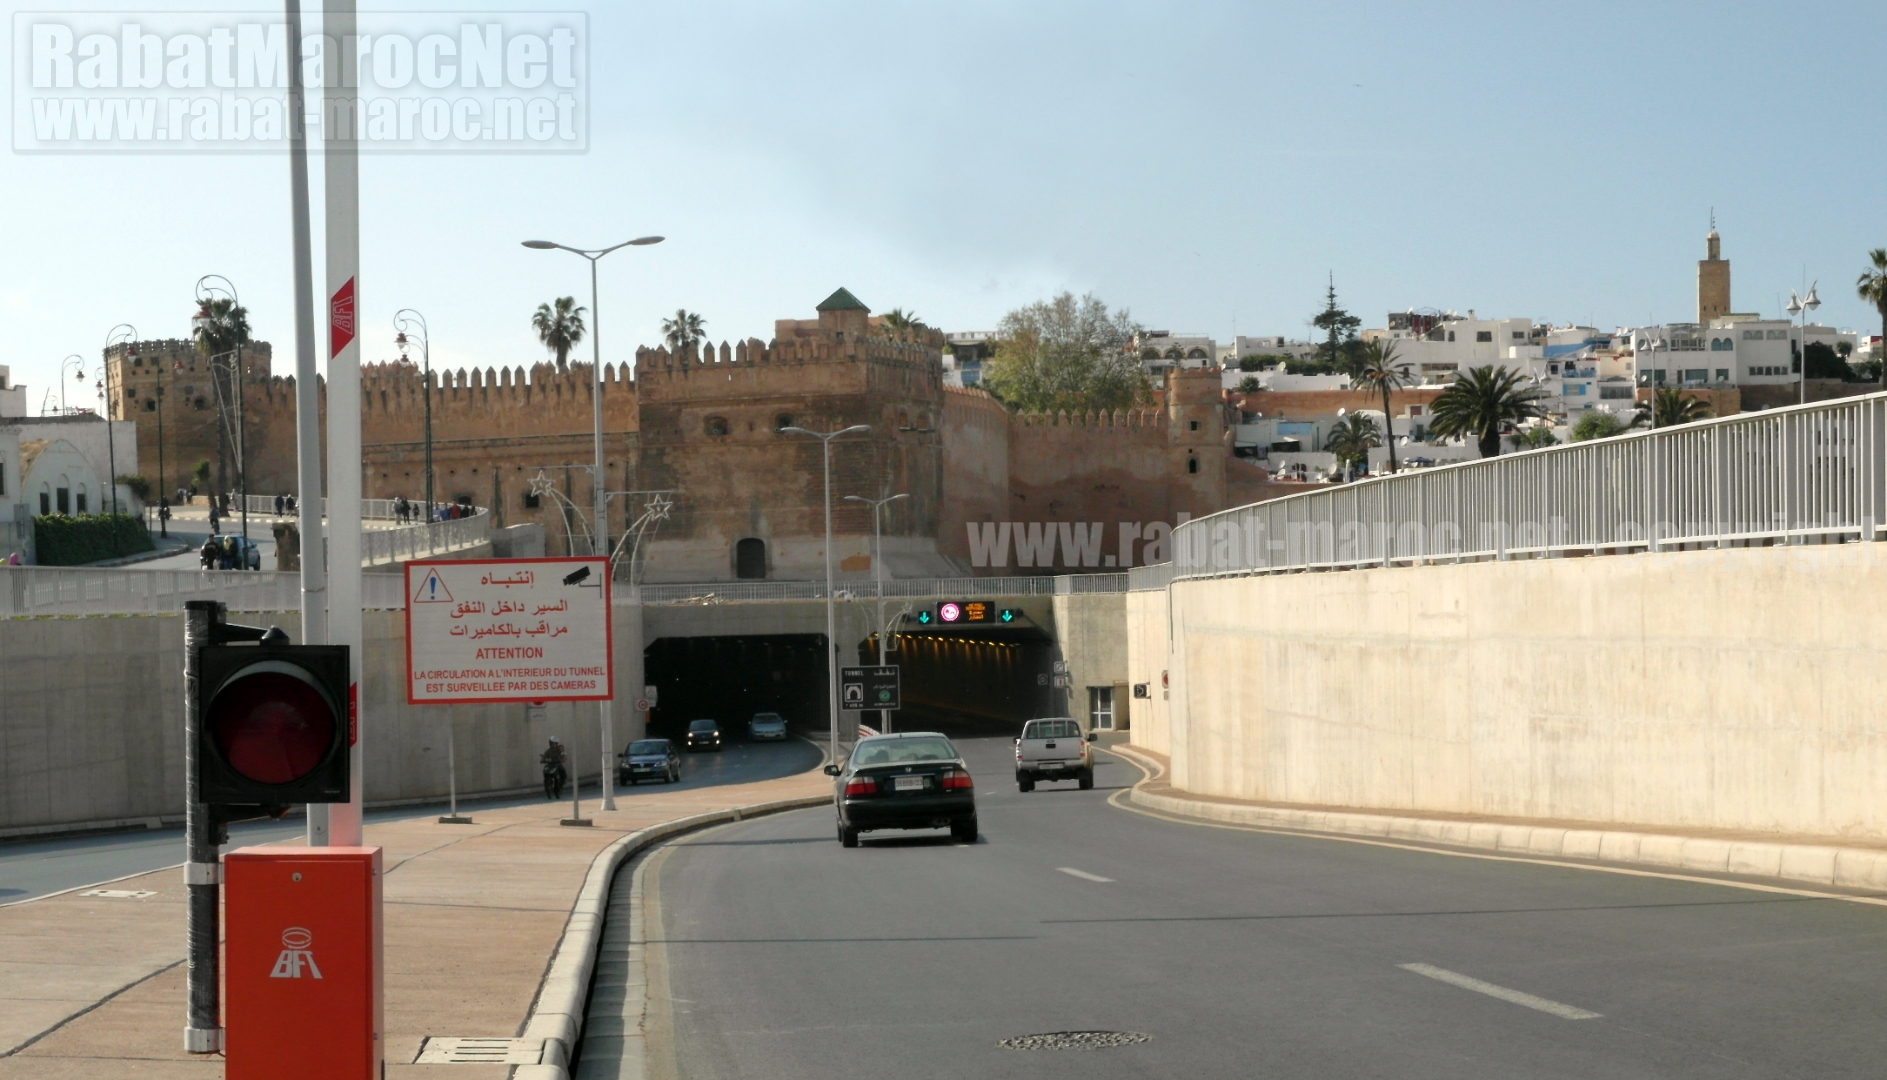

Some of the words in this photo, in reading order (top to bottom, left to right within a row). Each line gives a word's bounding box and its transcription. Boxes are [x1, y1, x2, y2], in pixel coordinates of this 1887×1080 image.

[450, 600, 486, 619] النفق
[491, 600, 525, 616] داخل
[532, 599, 568, 616] السير
[449, 622, 521, 639] بالكاميرات
[525, 620, 568, 637] مراقب
[476, 647, 543, 660] ATTENTION
[414, 670, 427, 680] LA
[427, 669, 486, 680] CIRCULATION
[487, 669, 495, 678] A
[496, 667, 552, 678] L'INTERIEUR
[554, 667, 567, 677] DU
[569, 666, 606, 676] TUNNEL
[426, 683, 444, 693] EST
[447, 682, 506, 692] SURVEILLEE
[508, 681, 527, 691] PAR
[530, 680, 549, 690] DES
[551, 680, 596, 690] CAMERAS
[270, 950, 323, 979] BFT
